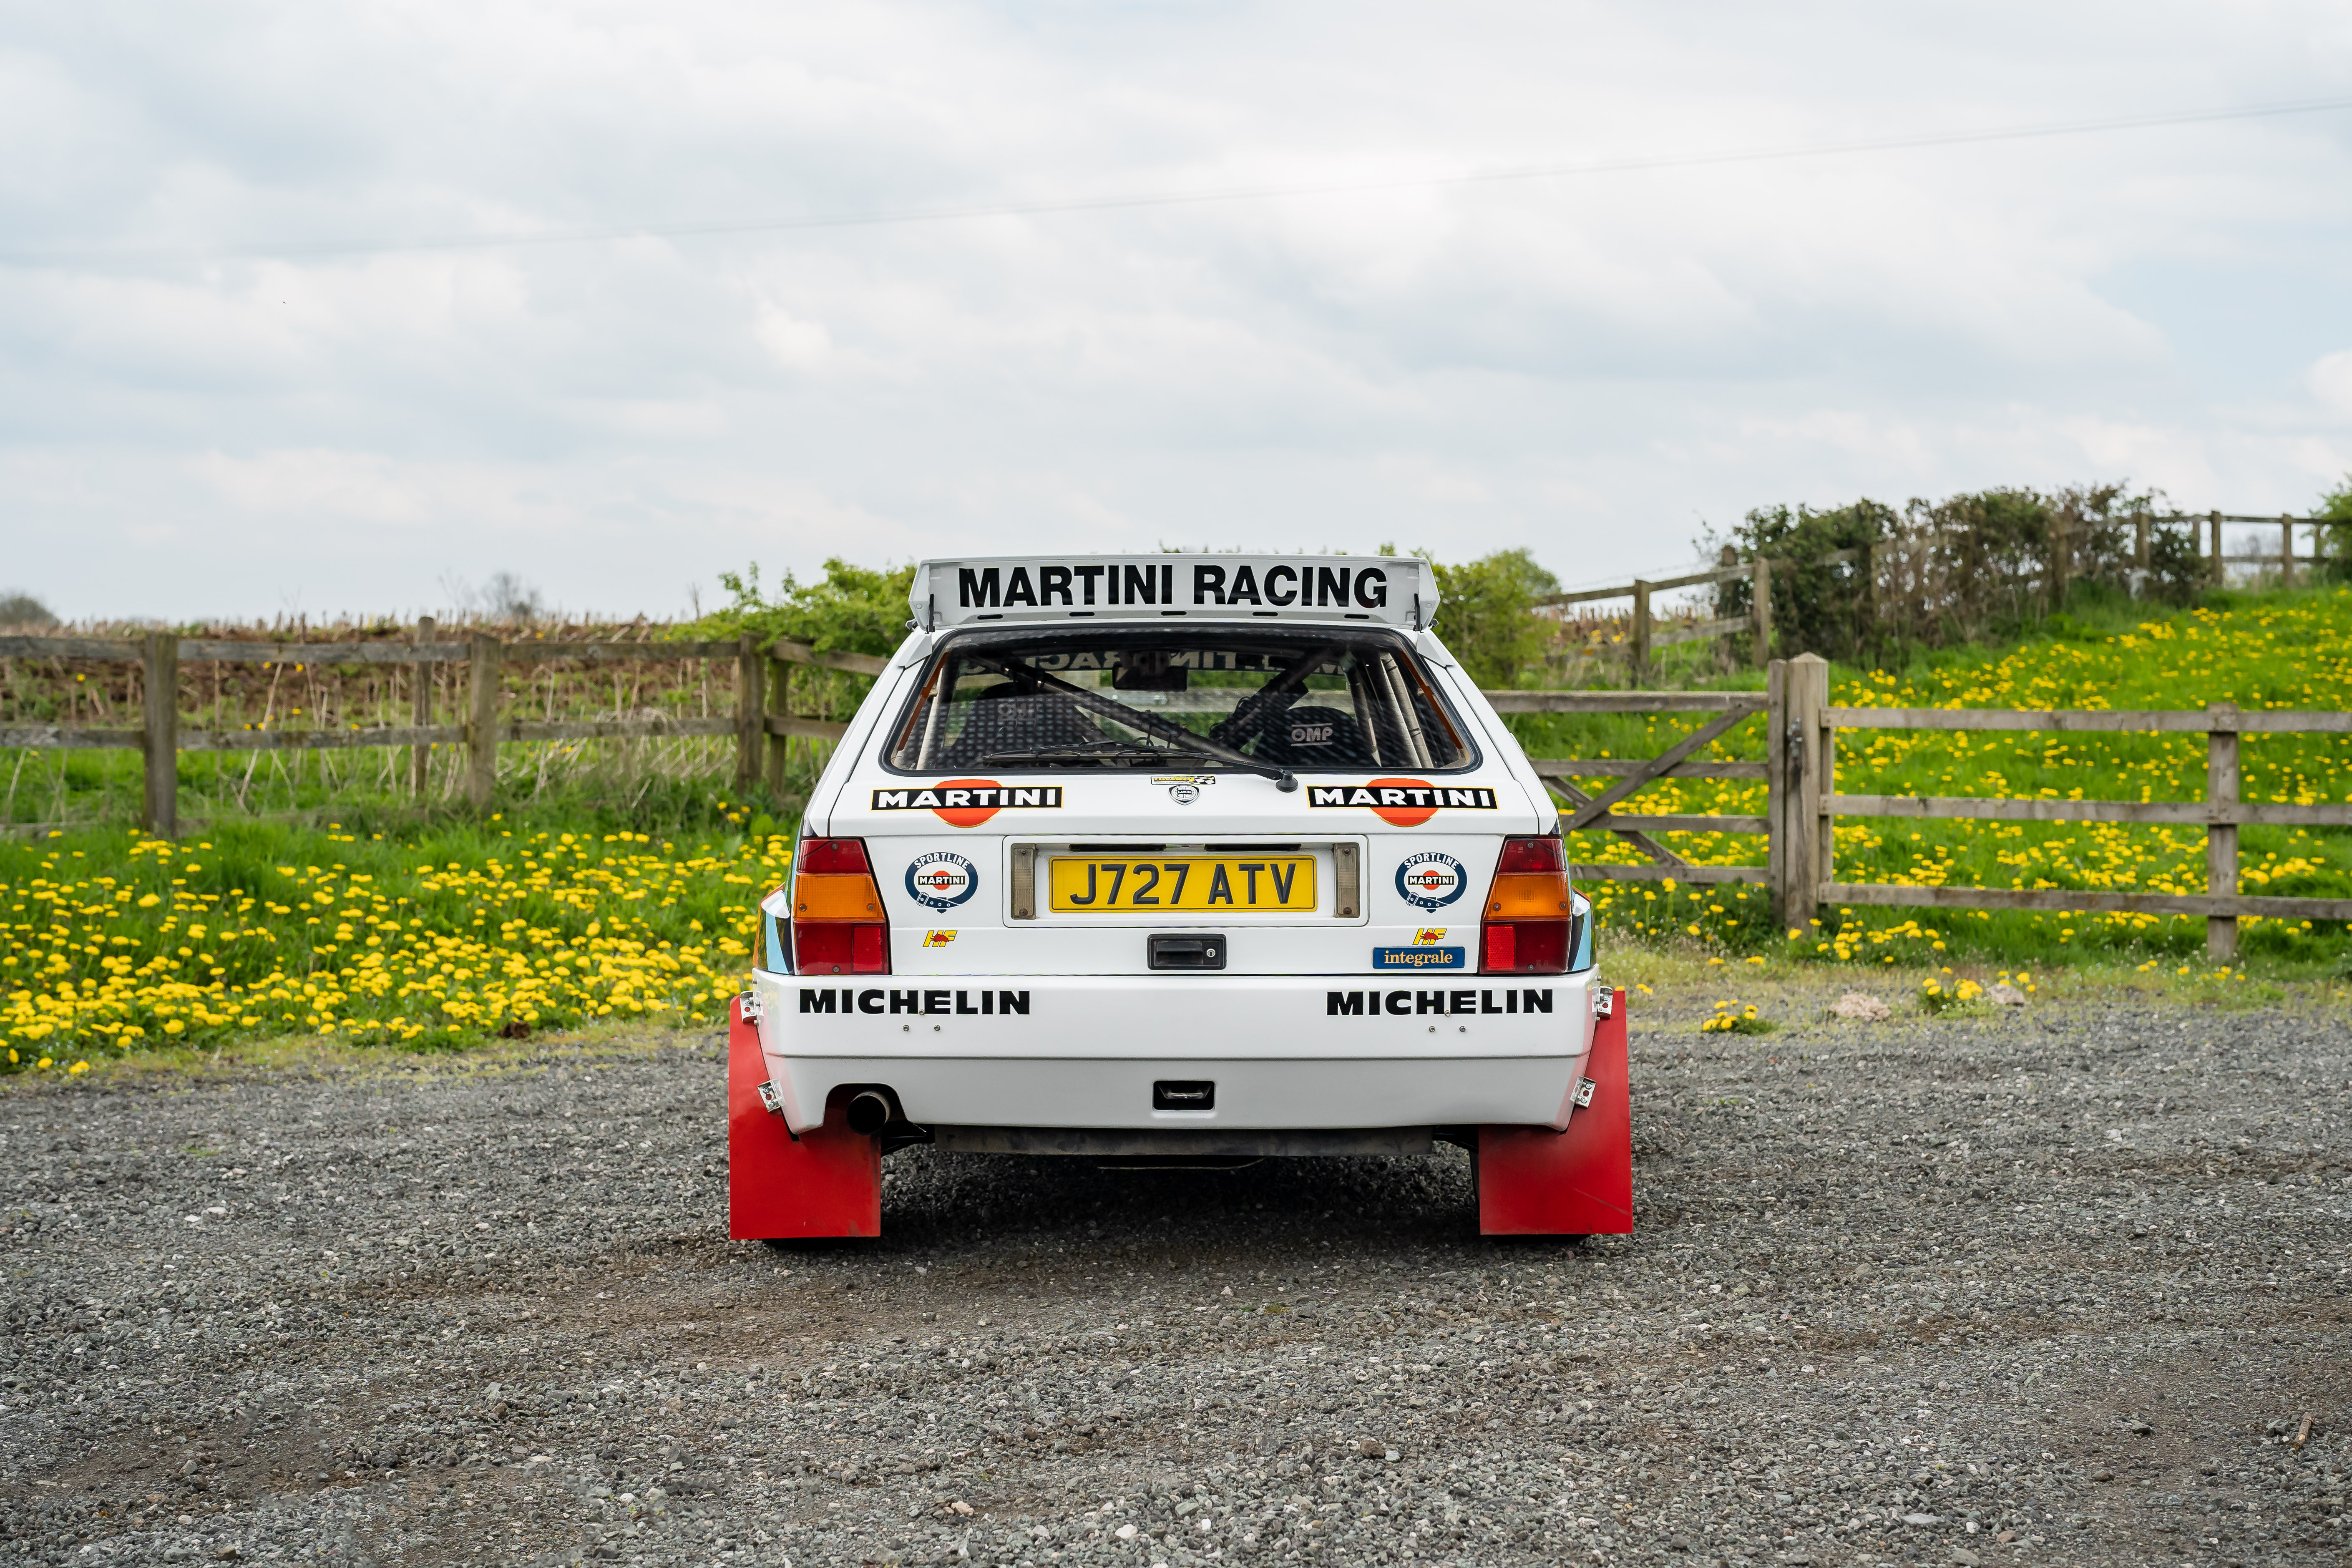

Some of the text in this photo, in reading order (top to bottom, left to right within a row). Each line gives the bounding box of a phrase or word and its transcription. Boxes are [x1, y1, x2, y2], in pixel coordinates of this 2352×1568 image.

[959, 565, 1387, 609] MARTINI RACING
[1291, 727, 1333, 742] OMP
[878, 789, 1056, 808] MARTINI
[1314, 788, 1491, 806] MARTINI
[914, 852, 971, 869] SPORTLINE
[1404, 852, 1459, 869] SPORTLINE
[919, 876, 964, 885] MARTINI
[1070, 863, 1296, 905] J727 ATV
[1409, 876, 1454, 885] MARTINI
[923, 930, 958, 947] HF
[1412, 928, 1447, 945] HF
[1384, 950, 1453, 966] integrale
[799, 989, 1030, 1014] MICHELIN
[1326, 989, 1553, 1016] MICHELIN
